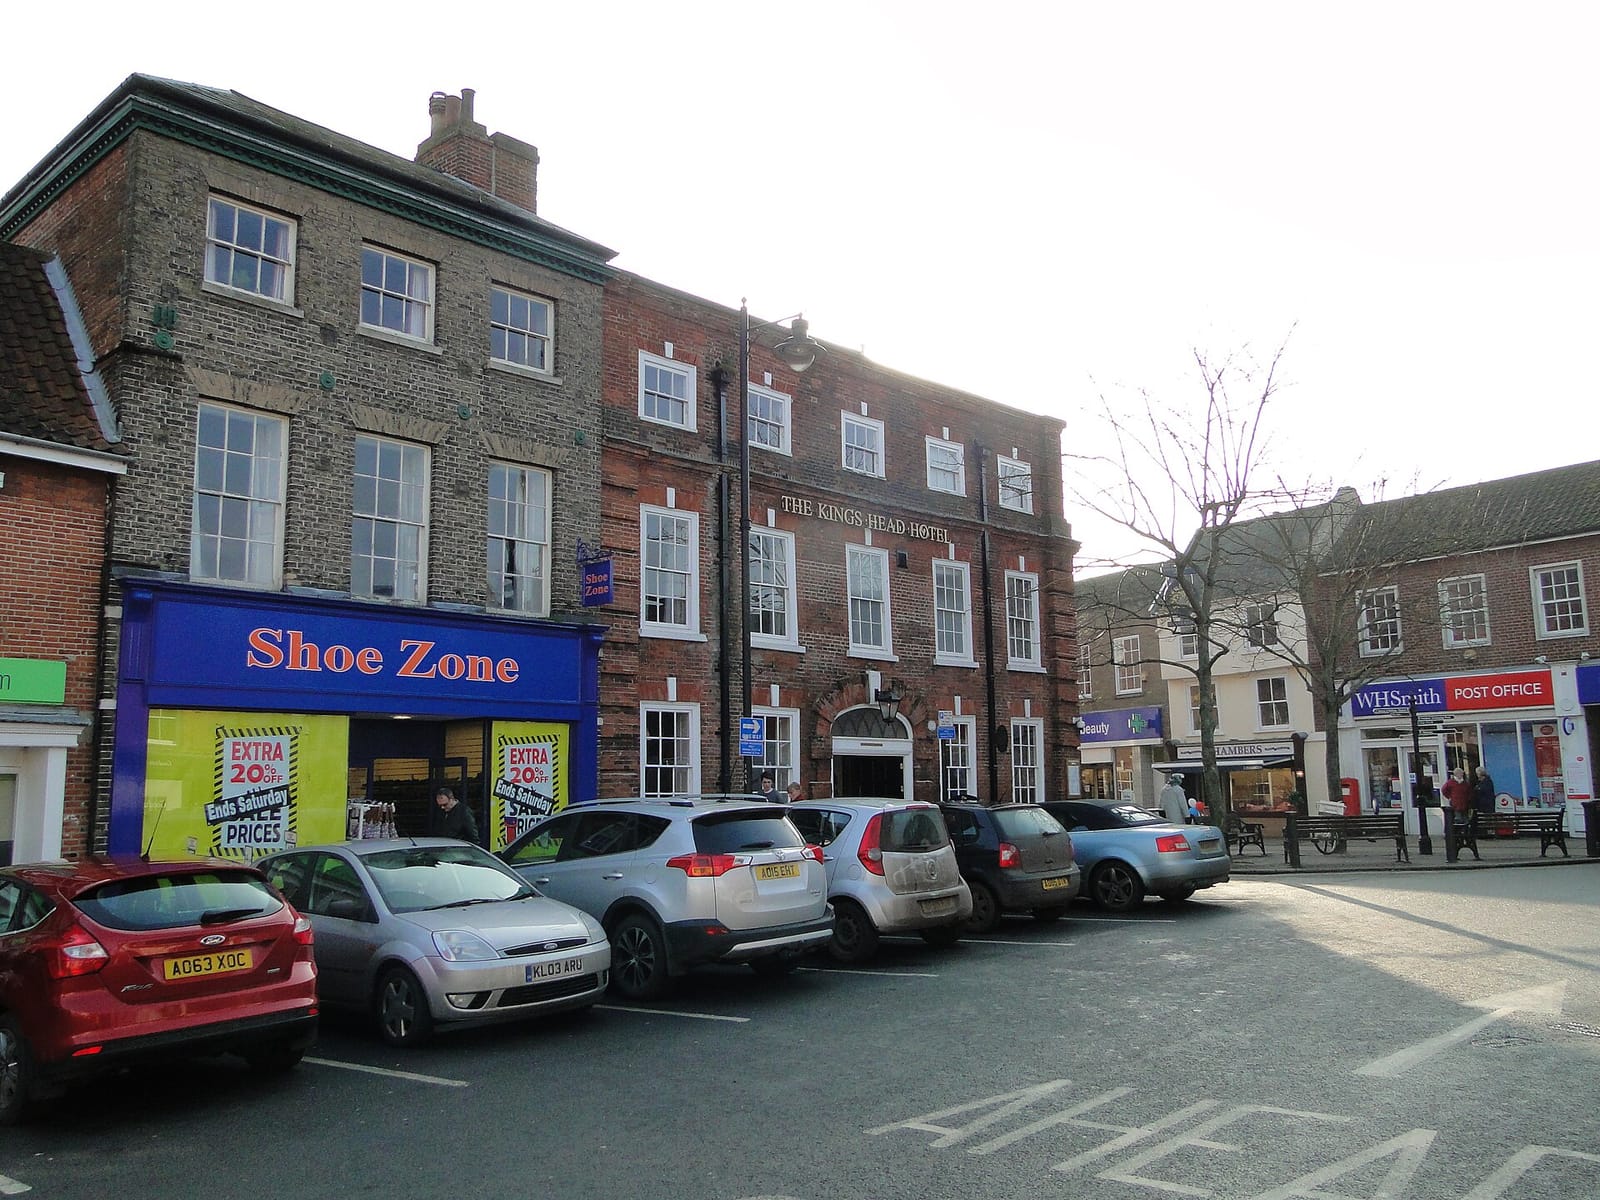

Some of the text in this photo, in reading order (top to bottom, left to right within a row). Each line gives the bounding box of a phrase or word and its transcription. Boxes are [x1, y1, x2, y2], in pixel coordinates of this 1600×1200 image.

[781, 495, 813, 516] THE
[817, 502, 863, 527] KINGS
[910, 521, 951, 544] HOTEL
[585, 573, 608, 585] Shoe
[585, 585, 609, 597] Zone
[247, 627, 519, 683] Shoe Zone
[1355, 688, 1442, 709] WHSmith
[1454, 682, 1542, 700] POST OFFICE
[231, 741, 284, 761] EXTRA
[510, 748, 549, 765] EXTRA
[1214, 745, 1263, 756] HAMBERS
[230, 763, 283, 784] 20% OFF
[534, 776, 549, 784] OFF
[207, 789, 288, 821] Ends Saturday
[495, 779, 552, 814] Ends Saturday
[227, 823, 281, 843] PRICES
[172, 952, 246, 975] AO63 XOC
[533, 959, 582, 978] KL03 ARU
